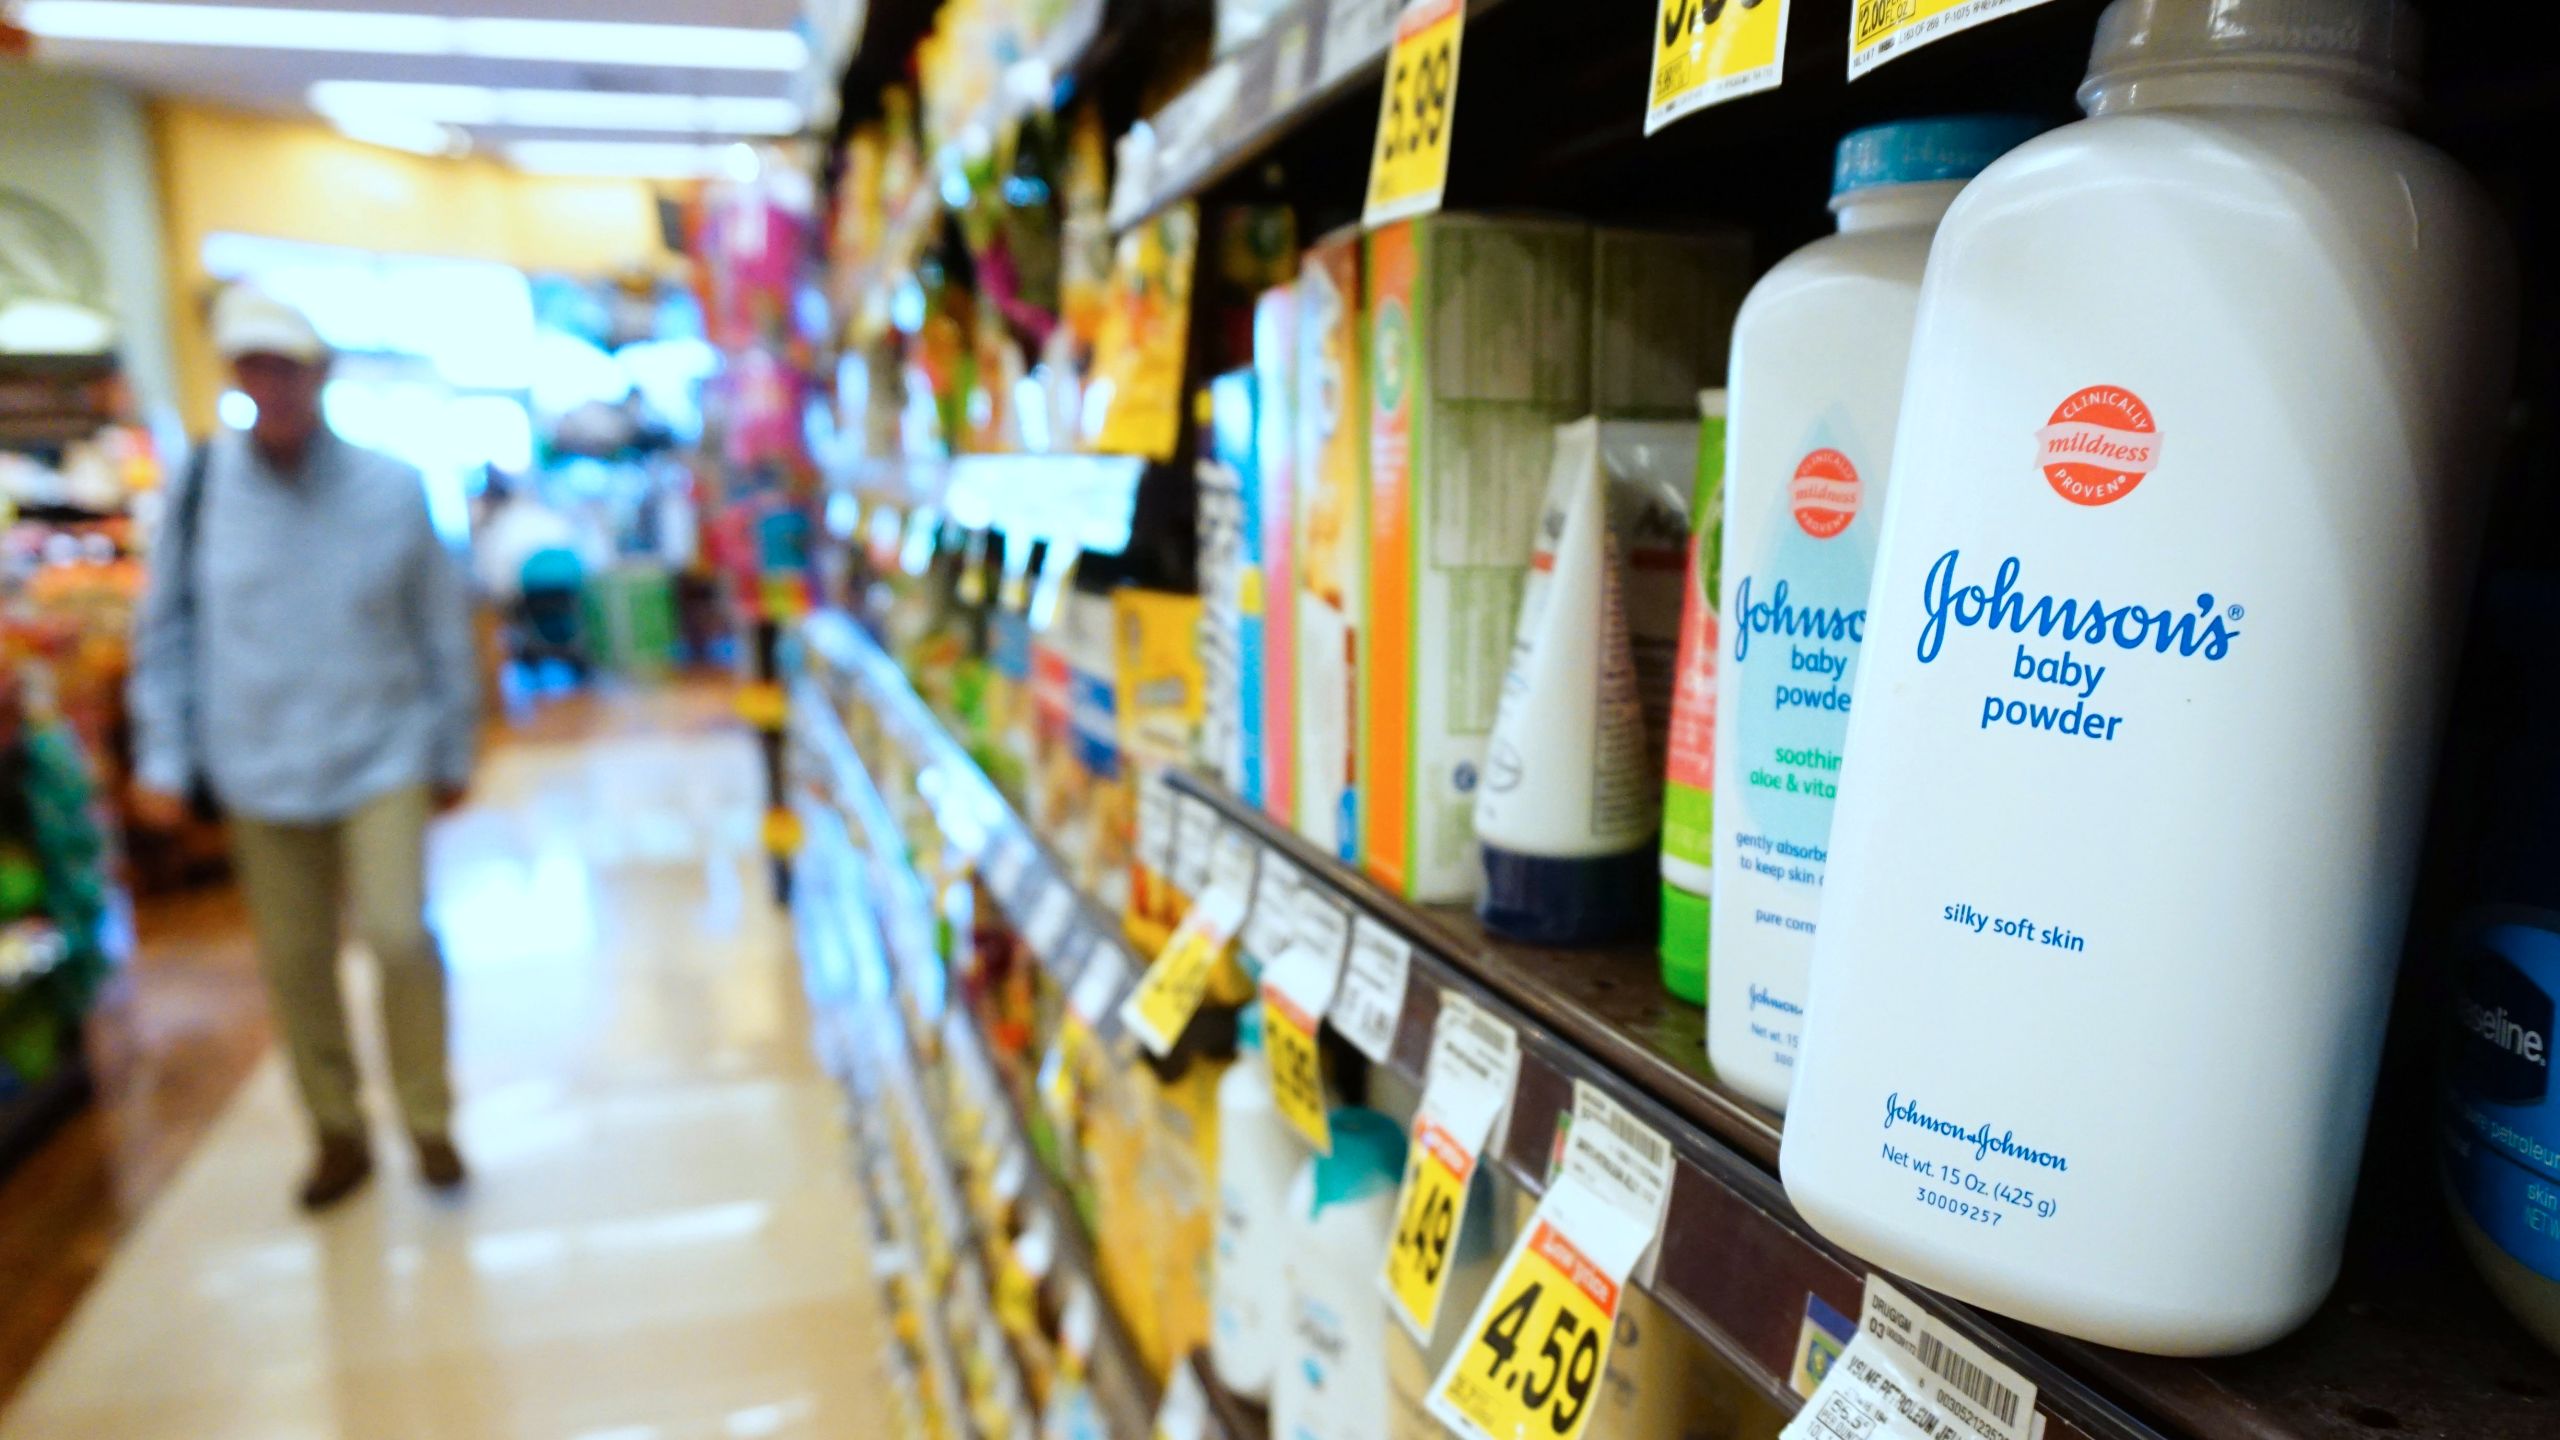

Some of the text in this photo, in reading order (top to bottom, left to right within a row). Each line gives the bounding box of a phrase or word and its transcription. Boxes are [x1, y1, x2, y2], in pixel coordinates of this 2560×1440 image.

[2063, 391, 2148, 429] CLINICALLY
[2047, 431, 2150, 462] mildness
[1791, 644, 1848, 681] baby
[2013, 644, 2106, 698] baby
[1775, 685, 1851, 712] powde
[1981, 695, 2123, 741] powder
[1749, 769, 1837, 799] aloe & vita
[1735, 832, 1774, 855] gently
[1740, 855, 1753, 870] to
[1755, 858, 1785, 881] keep
[1788, 865, 1815, 886] skin
[1755, 908, 1783, 926] pure
[1943, 903, 2085, 953] silky soft skin
[1881, 1143, 2057, 1219] Net wt. 15 Oz. (425 g)
[2527, 1183, 2558, 1211] skin
[1916, 1187, 2002, 1226] 30009257
[1482, 1280, 1599, 1435] 4.59
